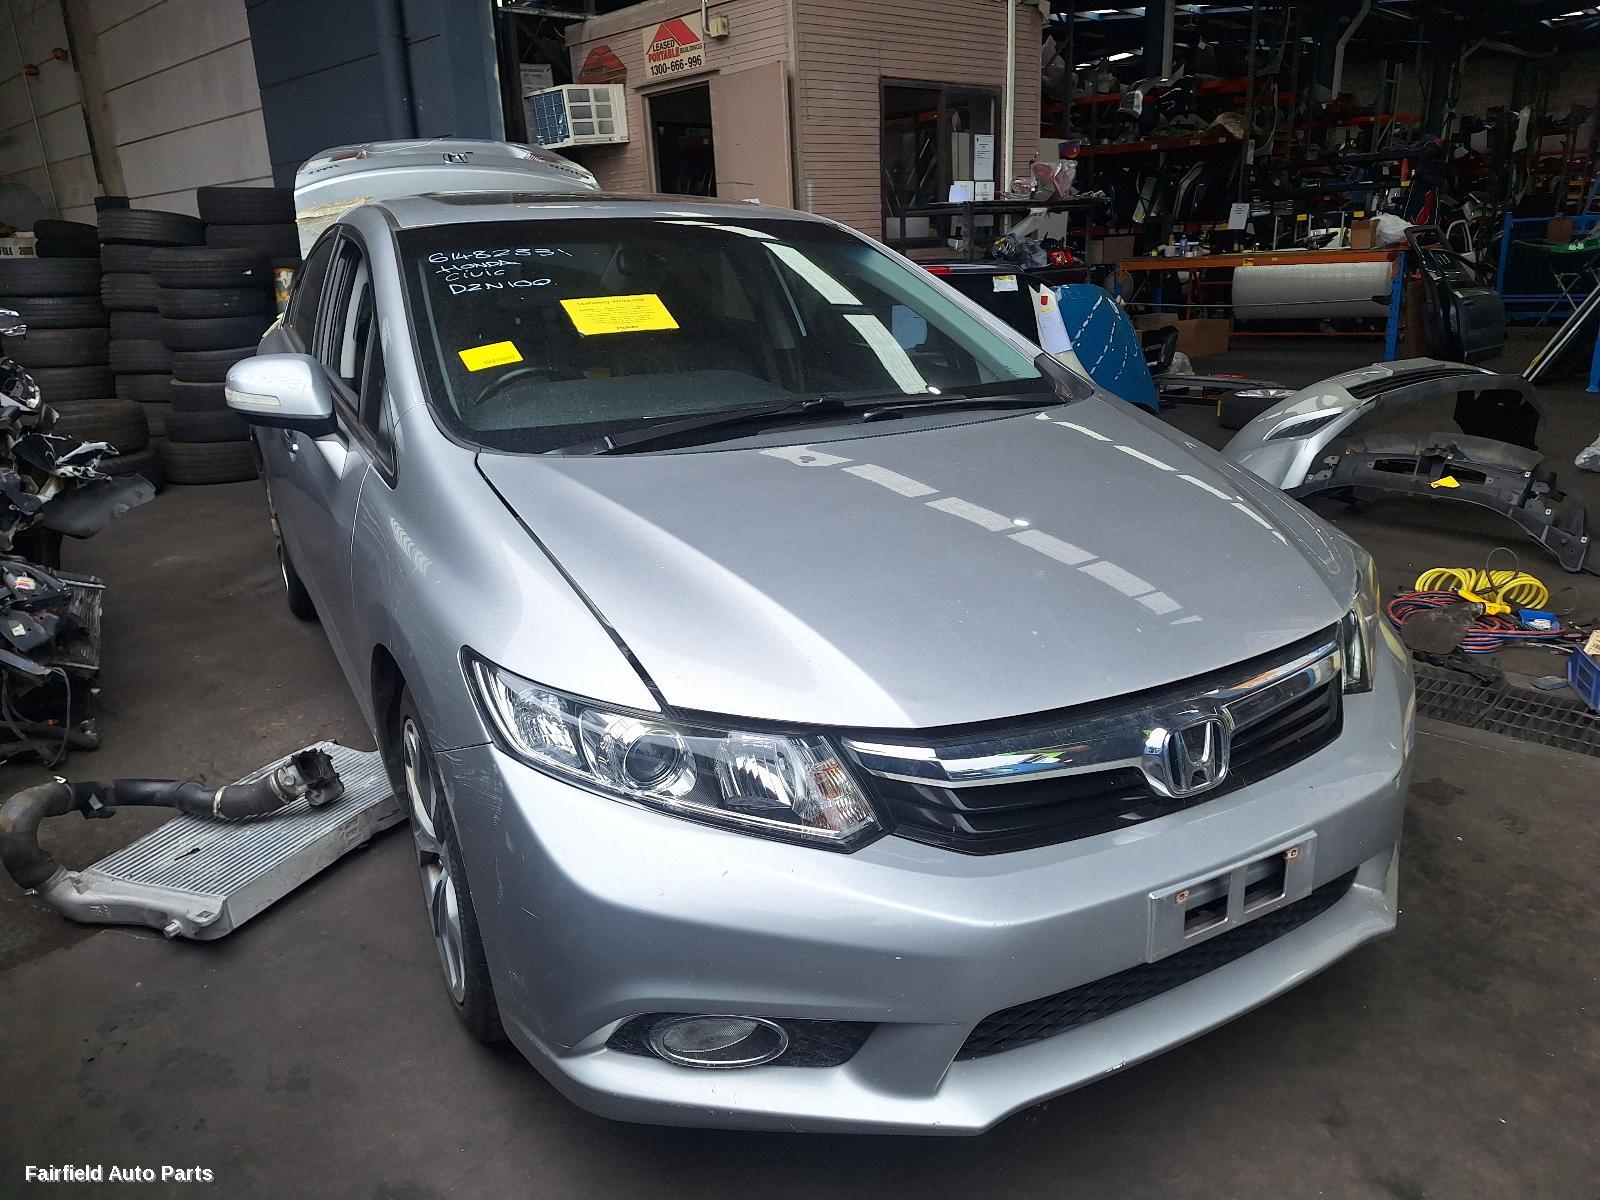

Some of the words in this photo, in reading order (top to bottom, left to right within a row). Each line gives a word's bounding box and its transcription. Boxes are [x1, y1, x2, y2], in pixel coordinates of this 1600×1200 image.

[648, 46, 680, 63] PORTABLE
[680, 42, 703, 54] BUILDINGS
[652, 39, 675, 52] LEASED
[650, 54, 703, 76] 1300-666-996
